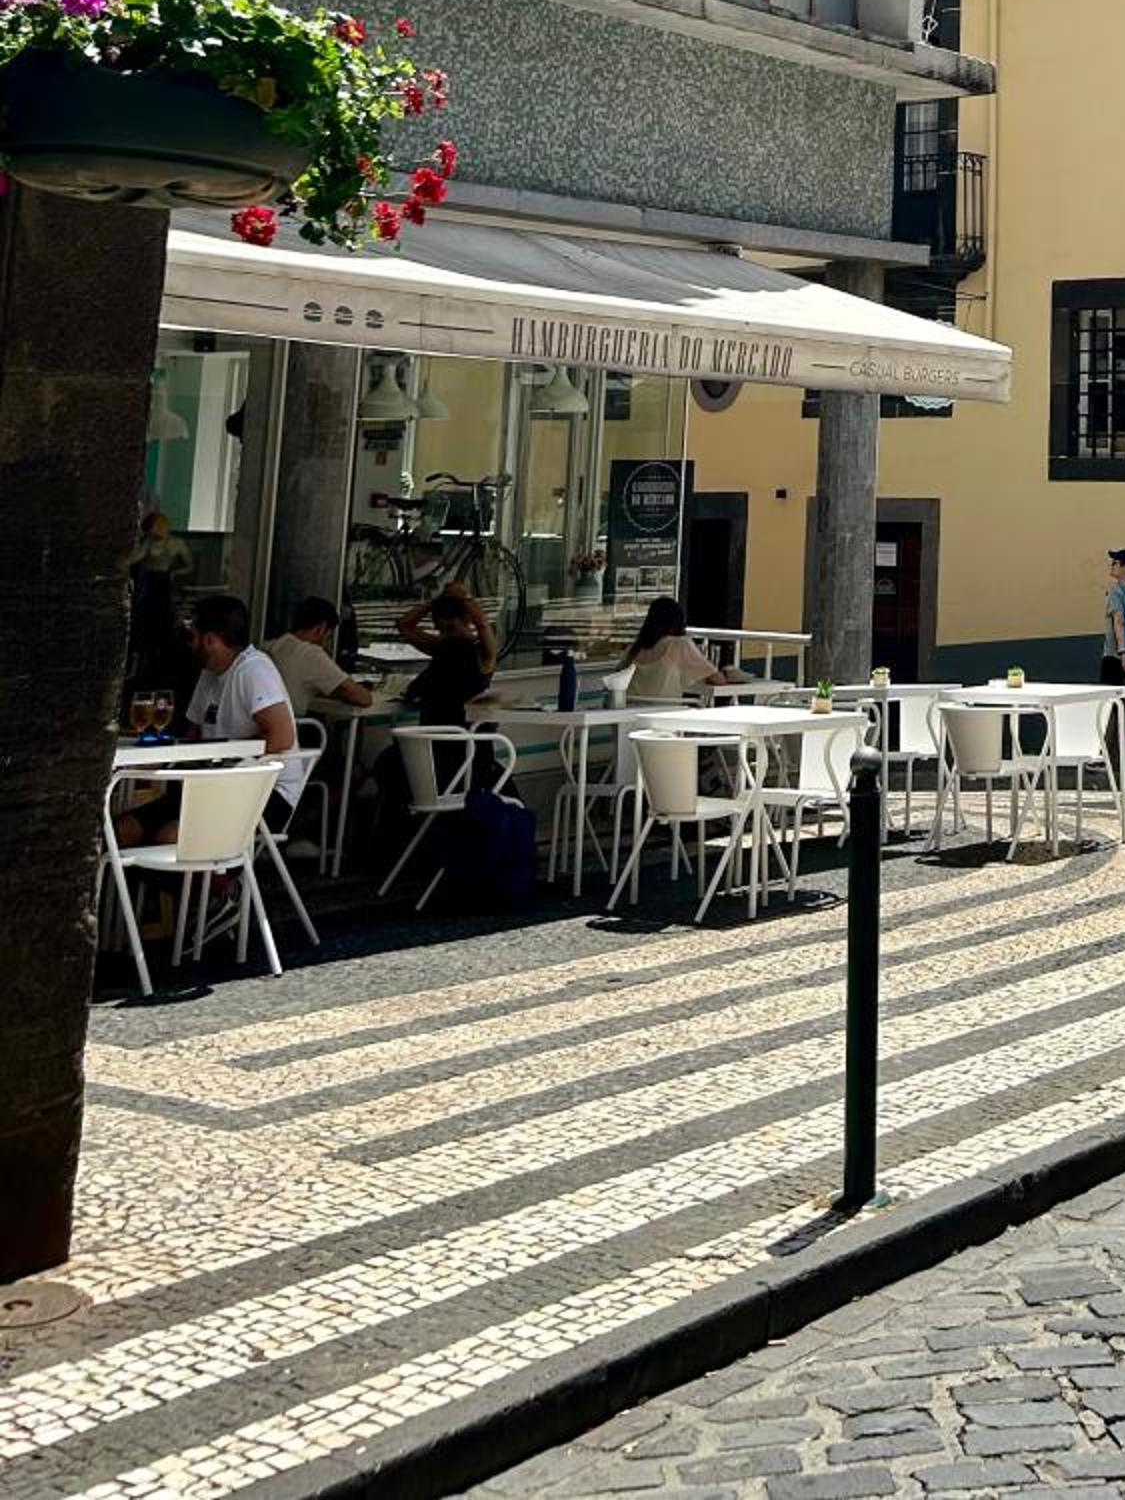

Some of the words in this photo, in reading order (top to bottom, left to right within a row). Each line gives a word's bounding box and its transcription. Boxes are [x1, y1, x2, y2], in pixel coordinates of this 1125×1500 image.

[511, 317, 669, 369] HAMBURGUERIA
[679, 335, 703, 371] DO
[710, 339, 793, 378] MERCADO
[850, 360, 900, 381] CASUAL
[903, 365, 961, 386] BURGERS
